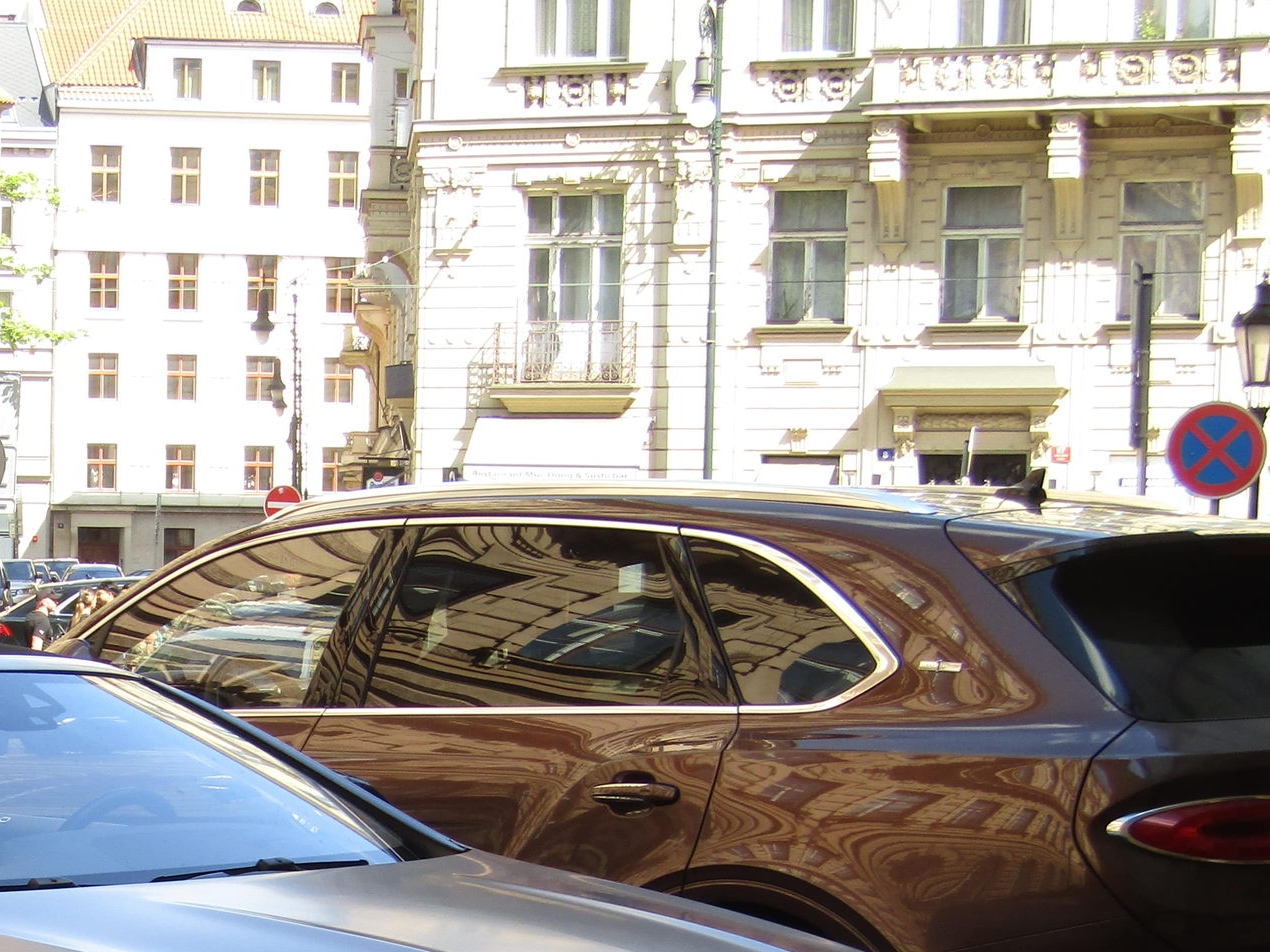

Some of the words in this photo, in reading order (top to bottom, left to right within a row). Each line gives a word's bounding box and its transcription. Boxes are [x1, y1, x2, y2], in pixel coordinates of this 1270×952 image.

[472, 470, 522, 479] Restaurant
[575, 471, 582, 479] &
[584, 471, 610, 479] Sushi
